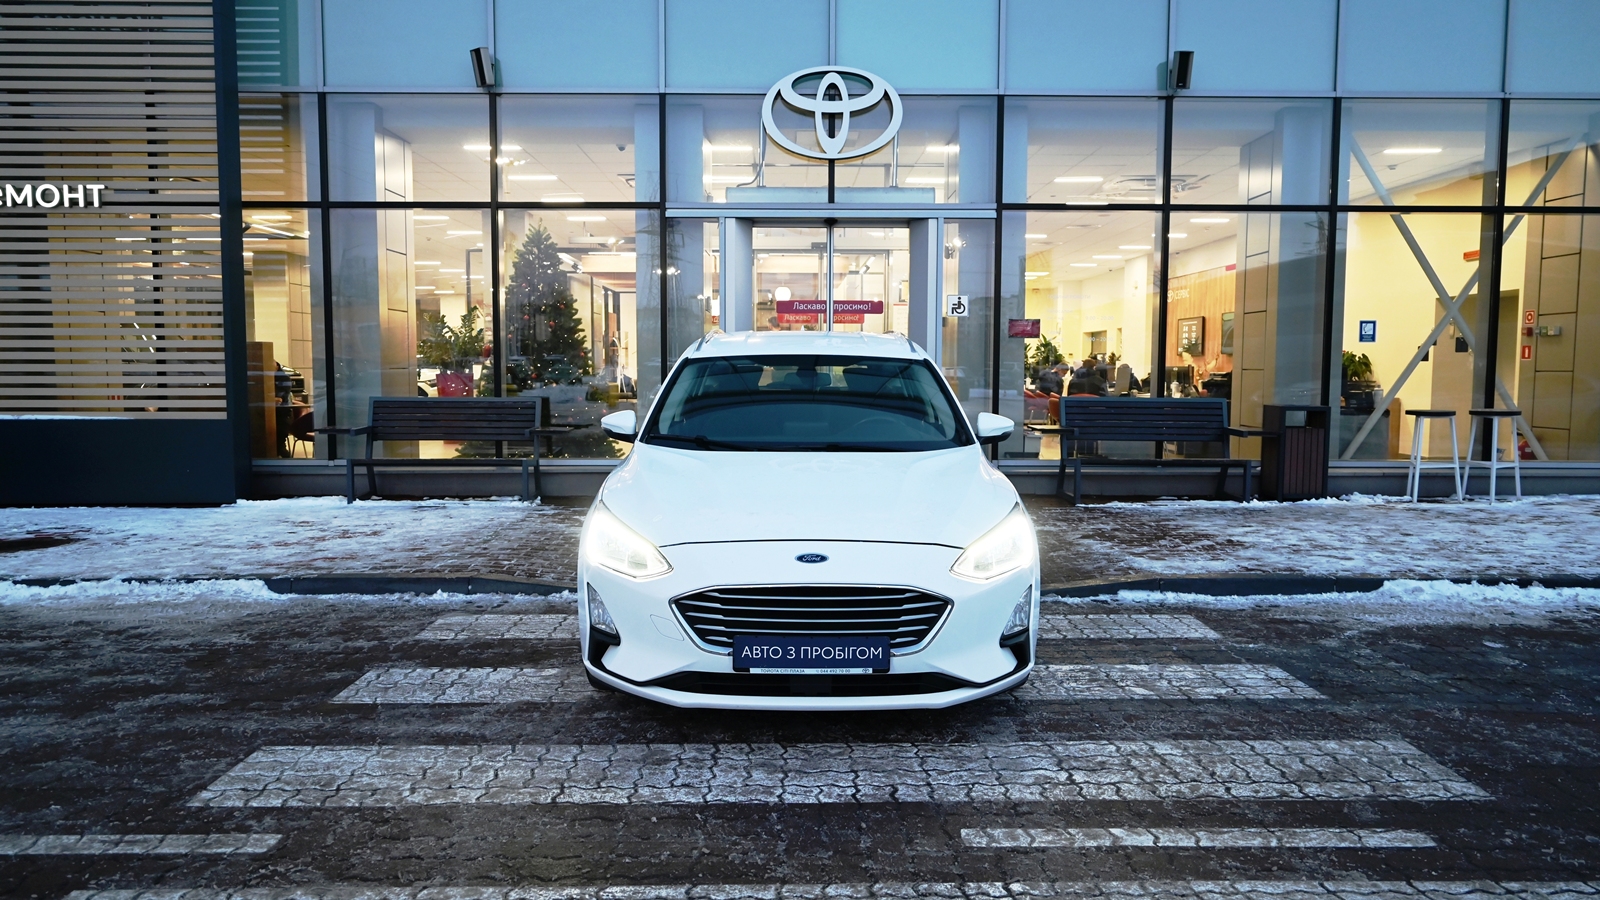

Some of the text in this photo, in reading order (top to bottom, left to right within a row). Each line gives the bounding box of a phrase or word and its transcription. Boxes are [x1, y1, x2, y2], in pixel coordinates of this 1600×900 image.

[0, 183, 105, 208] МОНТ
[793, 302, 871, 311] Ласкаво просимо!
[741, 645, 782, 659] АВТО
[800, 646, 882, 659] ПРОБІГОМ
